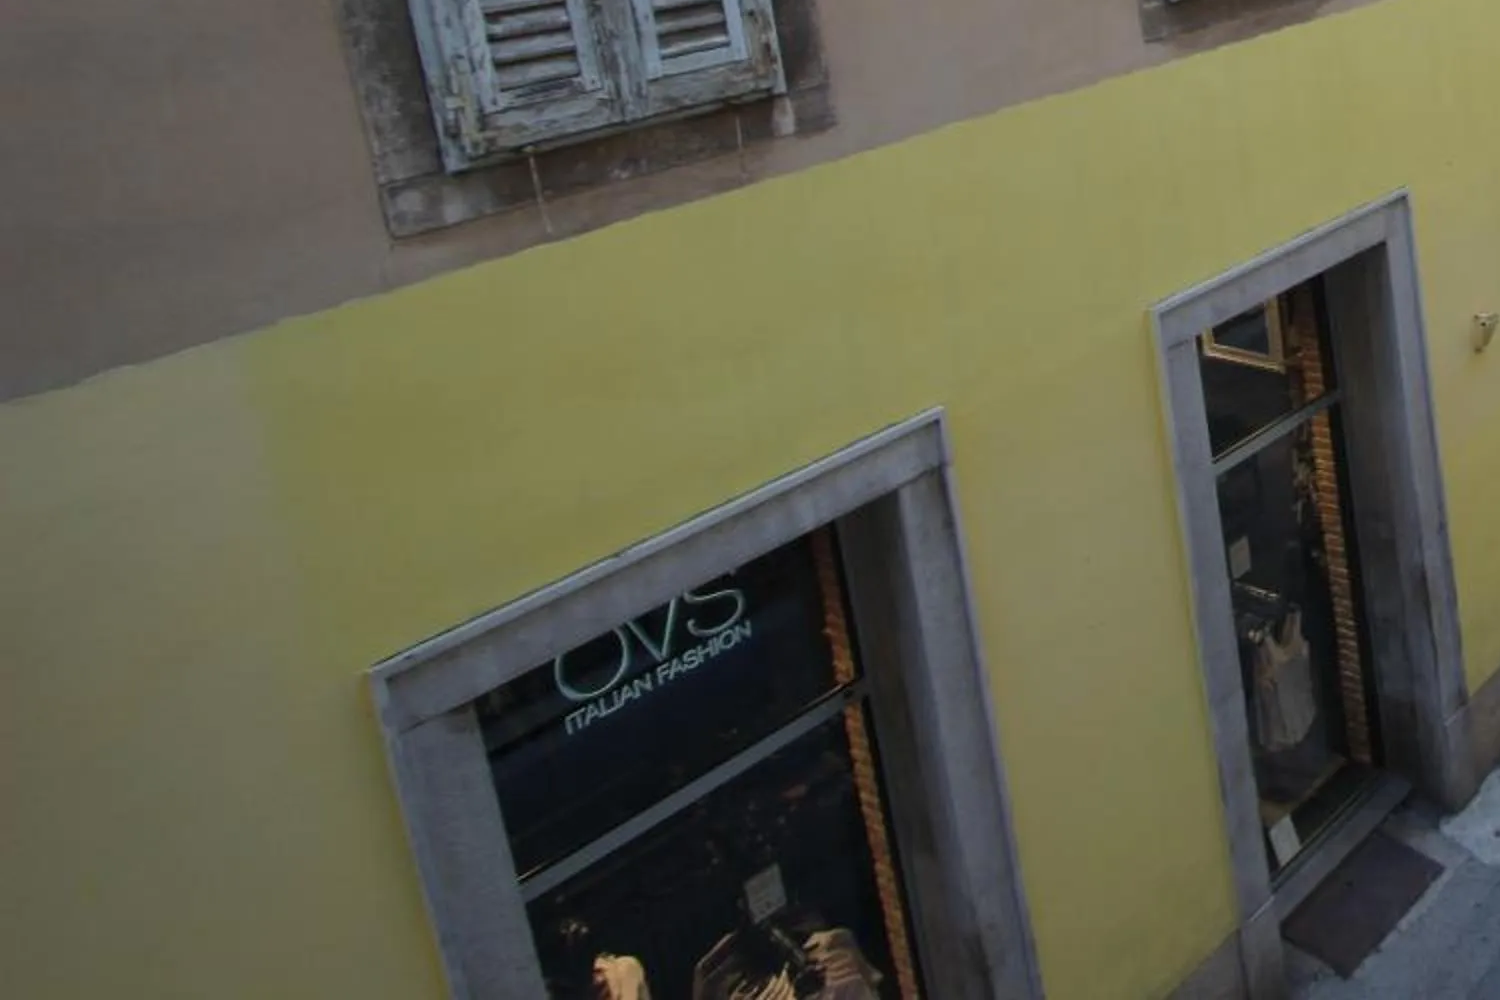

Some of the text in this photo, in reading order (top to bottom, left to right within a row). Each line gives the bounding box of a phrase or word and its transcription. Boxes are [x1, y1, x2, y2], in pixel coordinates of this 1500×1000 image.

[554, 589, 745, 700] OVS
[564, 620, 752, 736] ITALIAN FASHION
